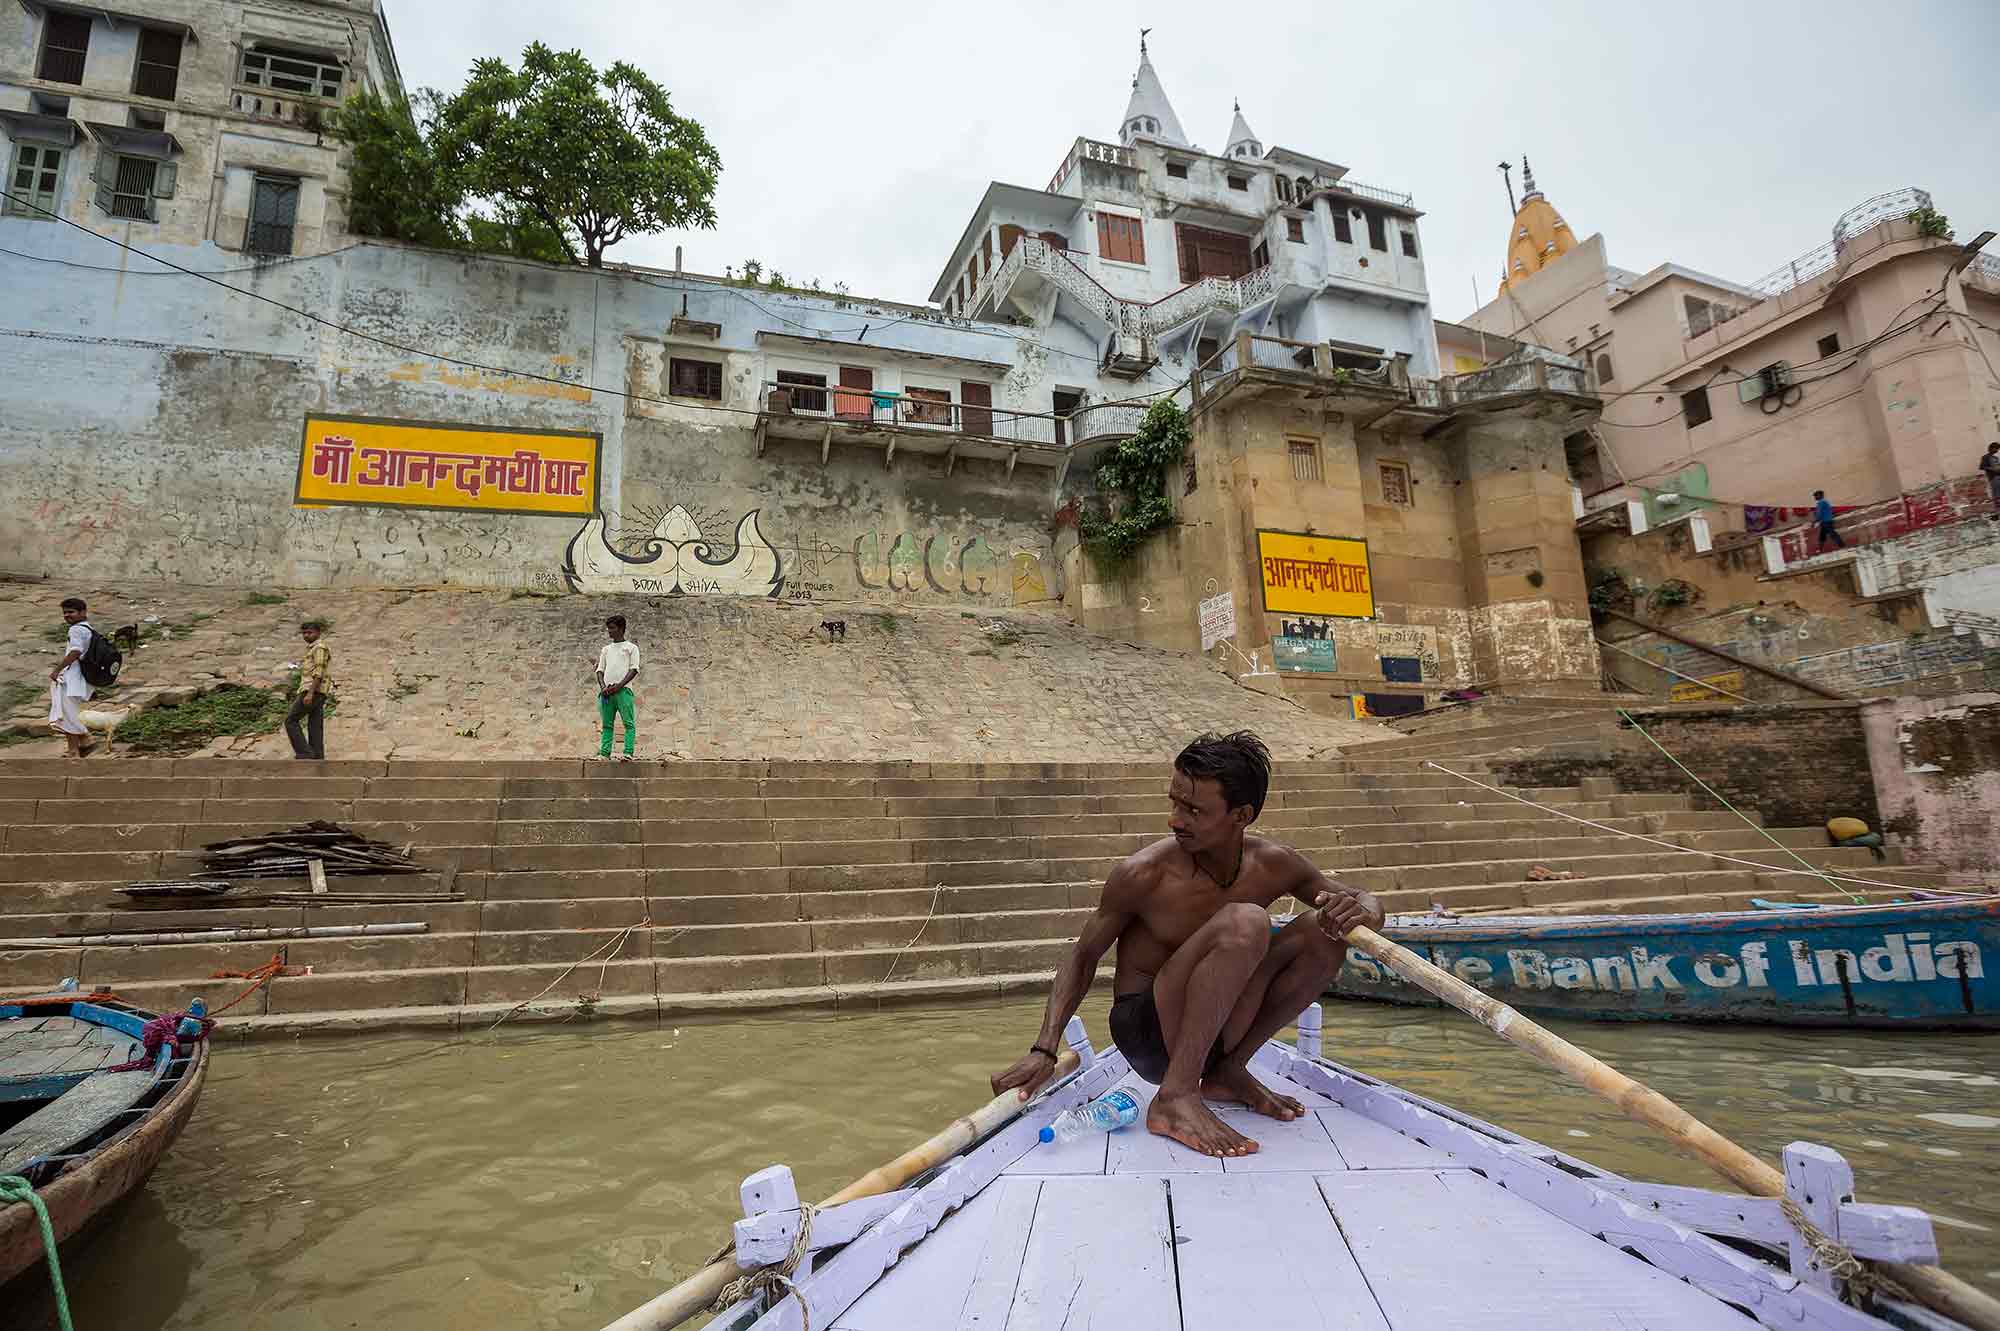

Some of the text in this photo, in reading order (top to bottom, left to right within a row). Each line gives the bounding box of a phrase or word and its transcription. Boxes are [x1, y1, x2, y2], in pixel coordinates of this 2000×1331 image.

[543, 460, 588, 496] घाट
[632, 578, 664, 592] BOOM
[1339, 563, 1369, 594] घाट
[1506, 946, 1680, 991] Bank
[1694, 941, 1770, 988] of
[1788, 932, 1985, 986] India
